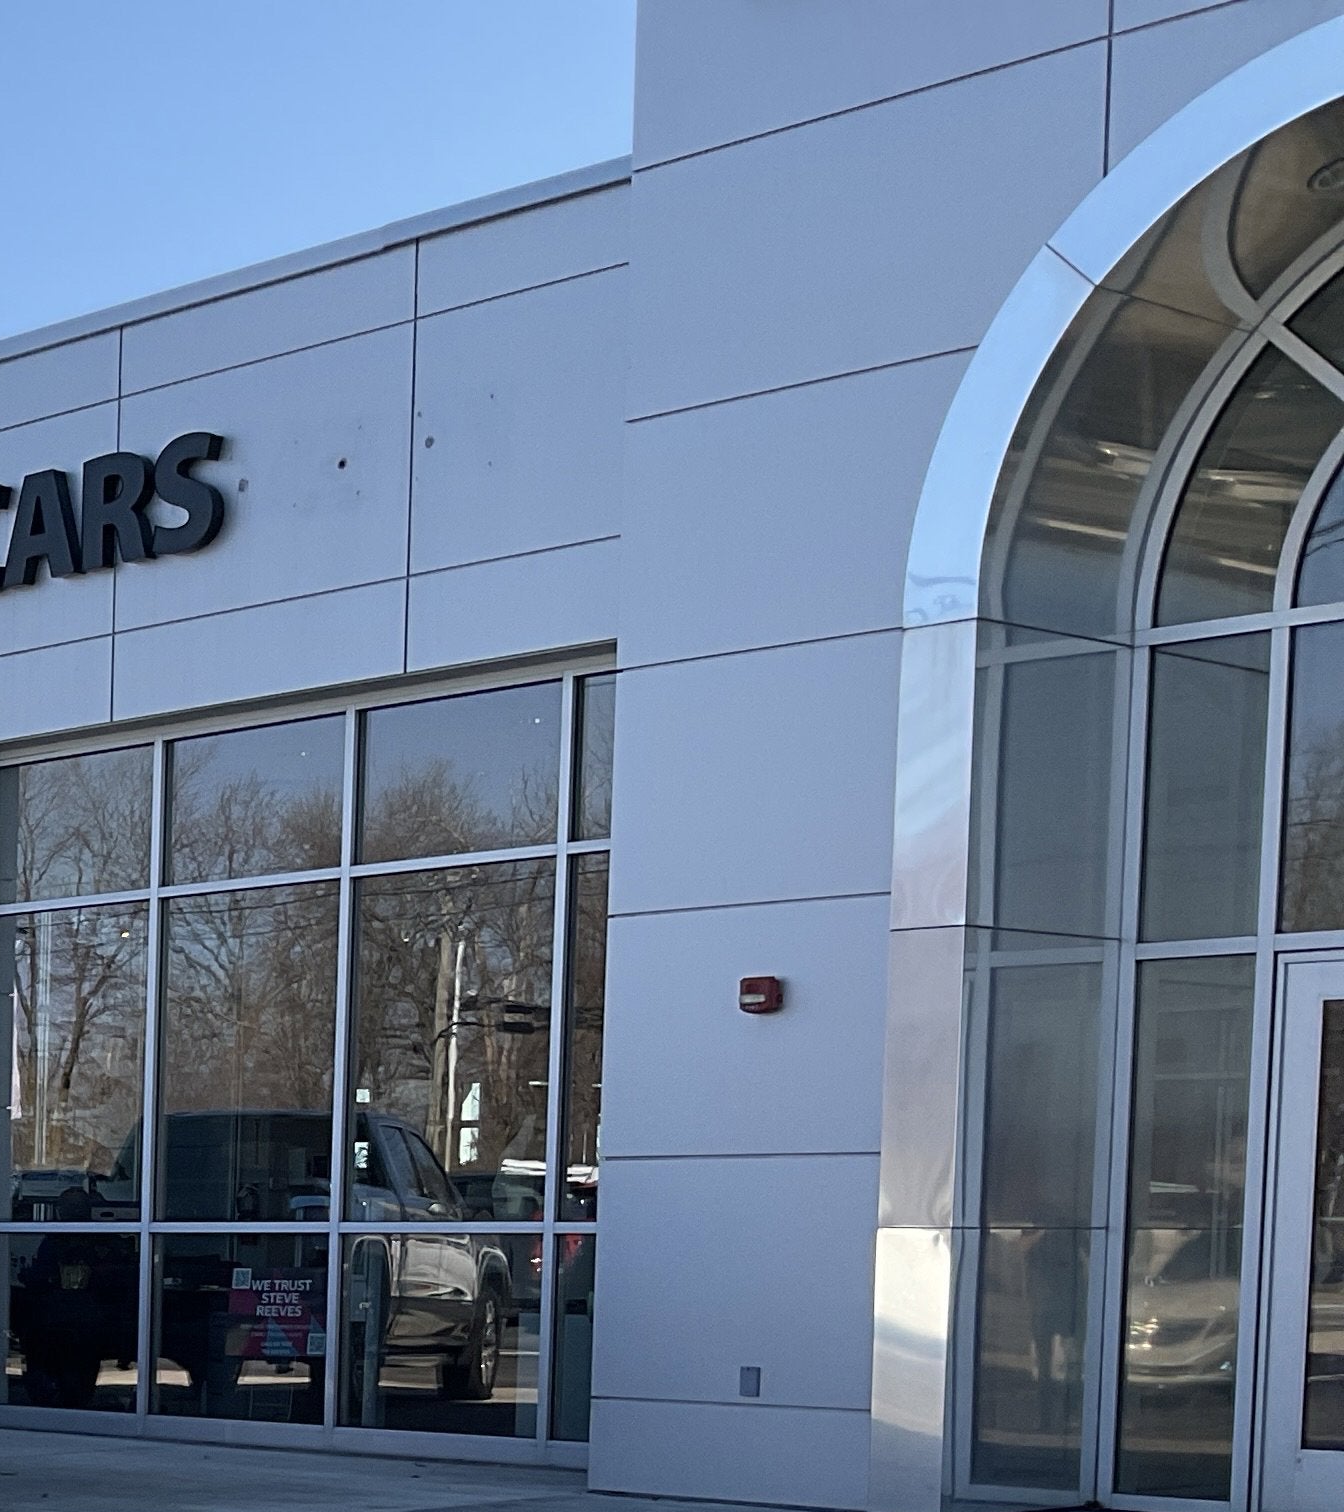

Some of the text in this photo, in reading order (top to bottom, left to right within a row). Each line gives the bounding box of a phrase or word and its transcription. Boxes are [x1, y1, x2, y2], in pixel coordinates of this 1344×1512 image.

[252, 1279, 312, 1291] WE TRUST
[261, 1292, 300, 1304] STEVE
[256, 1305, 302, 1317] REEVES
